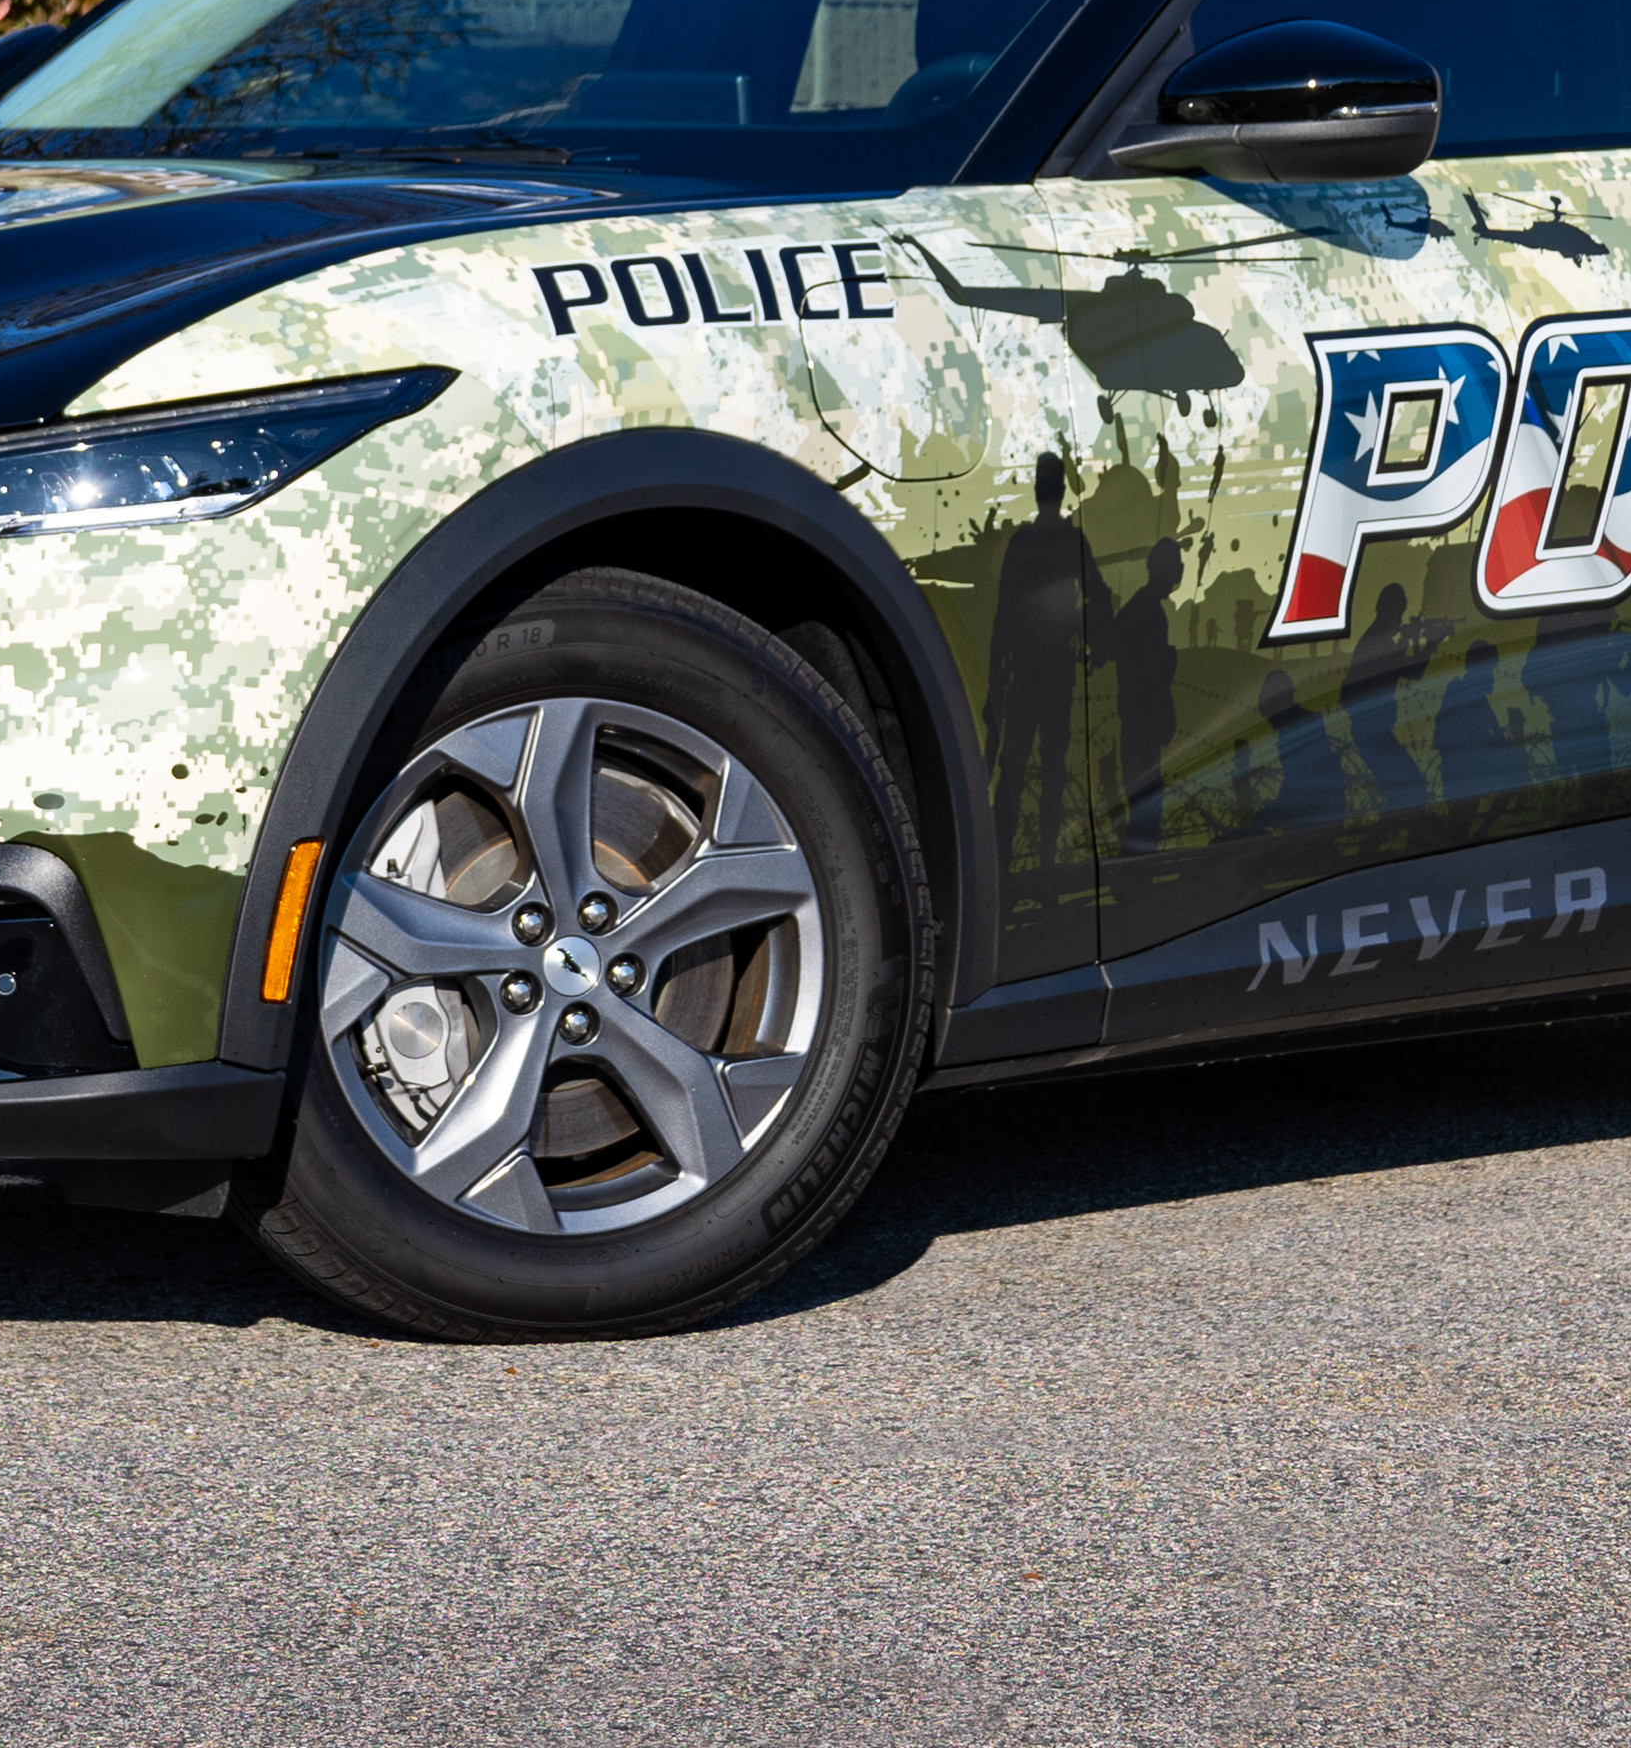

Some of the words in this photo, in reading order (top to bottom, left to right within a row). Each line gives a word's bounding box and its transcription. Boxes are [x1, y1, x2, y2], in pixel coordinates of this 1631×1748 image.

[530, 241, 898, 338] POLICE
[496, 631, 511, 652] R
[520, 626, 543, 645] 18
[1246, 866, 1609, 992] NEVER
[769, 1043, 882, 1224] MICHELIN
[648, 1238, 749, 1295] PRIMACY
